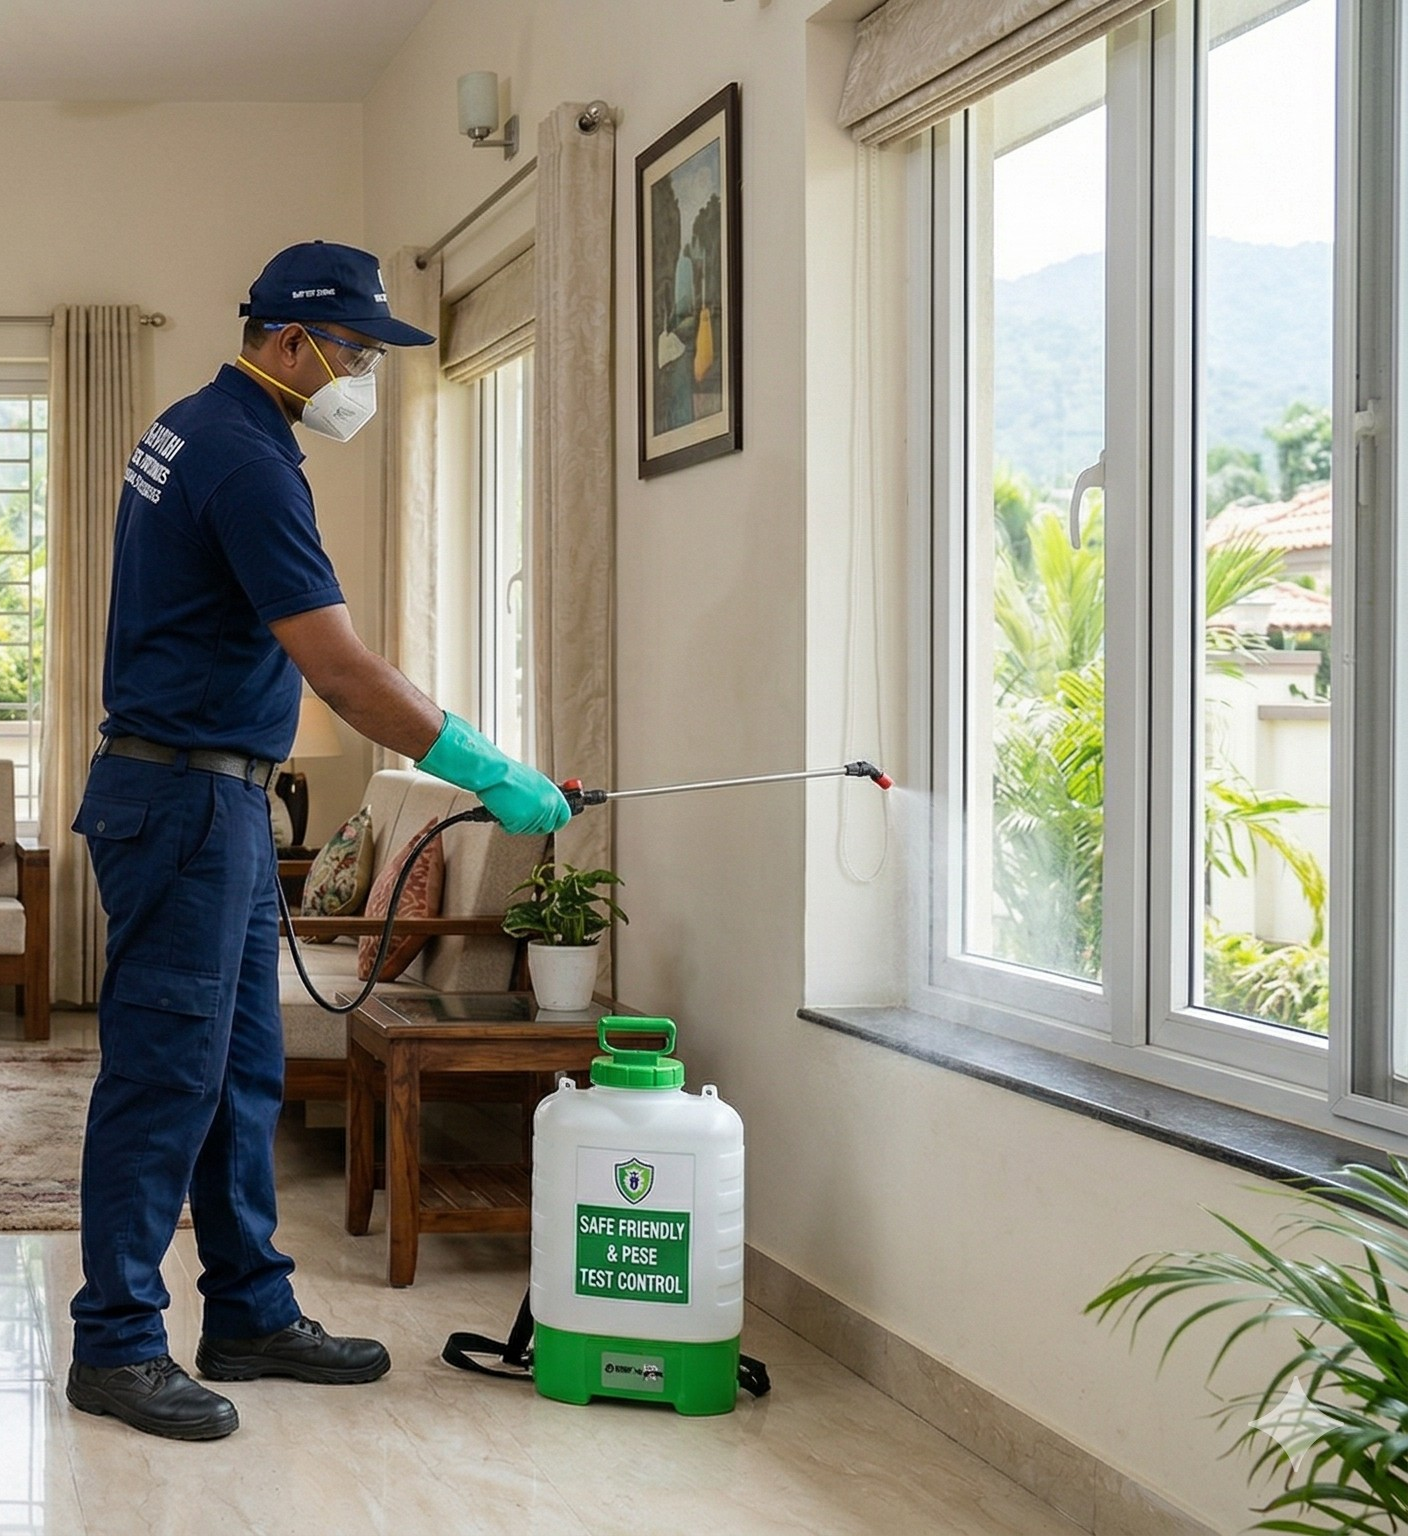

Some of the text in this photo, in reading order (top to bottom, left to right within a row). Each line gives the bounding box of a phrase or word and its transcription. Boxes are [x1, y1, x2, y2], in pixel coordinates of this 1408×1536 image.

[580, 1215, 685, 1240] SAFE FRIENDLY
[607, 1244, 657, 1266] & PESE
[580, 1268, 683, 1294] TEST CONTROL
